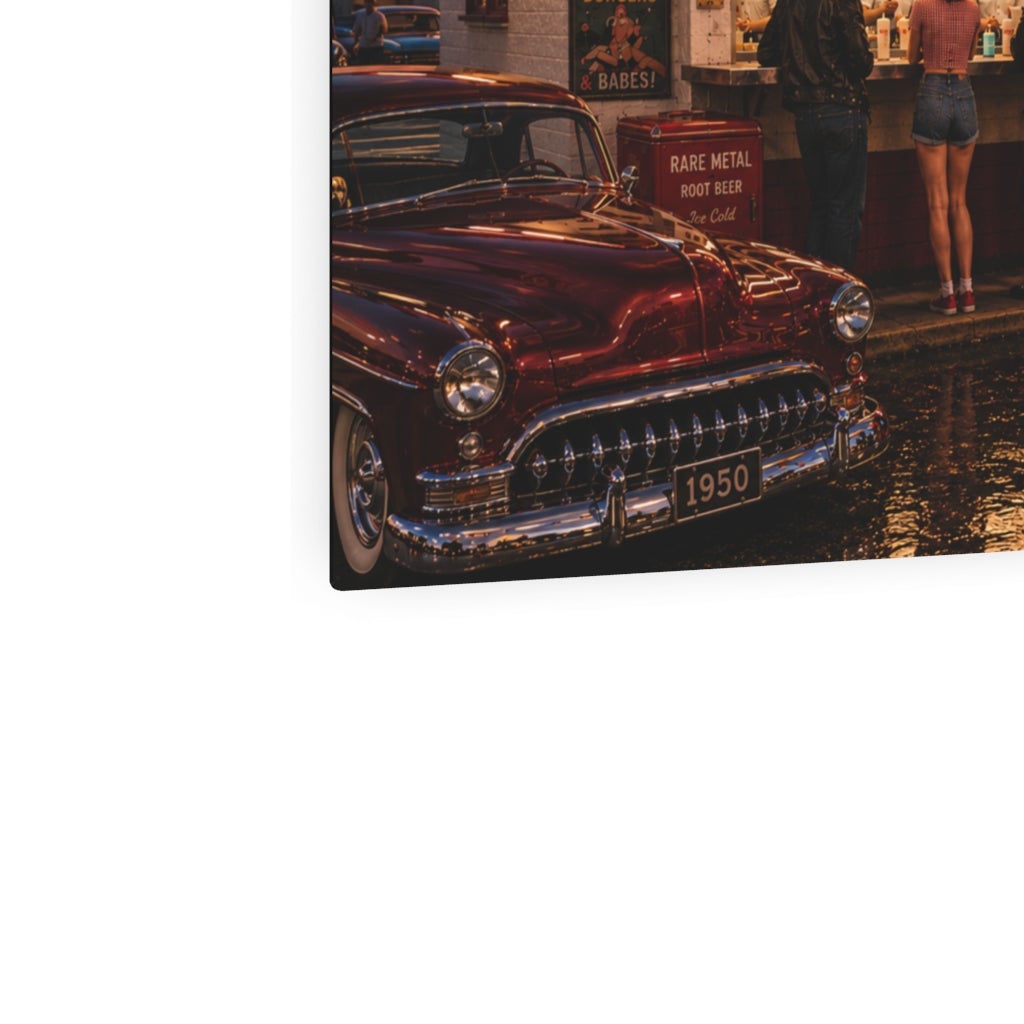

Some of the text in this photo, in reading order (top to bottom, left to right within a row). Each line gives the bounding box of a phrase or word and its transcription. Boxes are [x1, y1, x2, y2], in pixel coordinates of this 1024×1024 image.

[580, 71, 656, 90] & BABES!
[670, 150, 752, 173] RARE METAL
[681, 179, 743, 198] ROOT BEER
[710, 206, 737, 224] Cold
[686, 464, 749, 506] 1950
